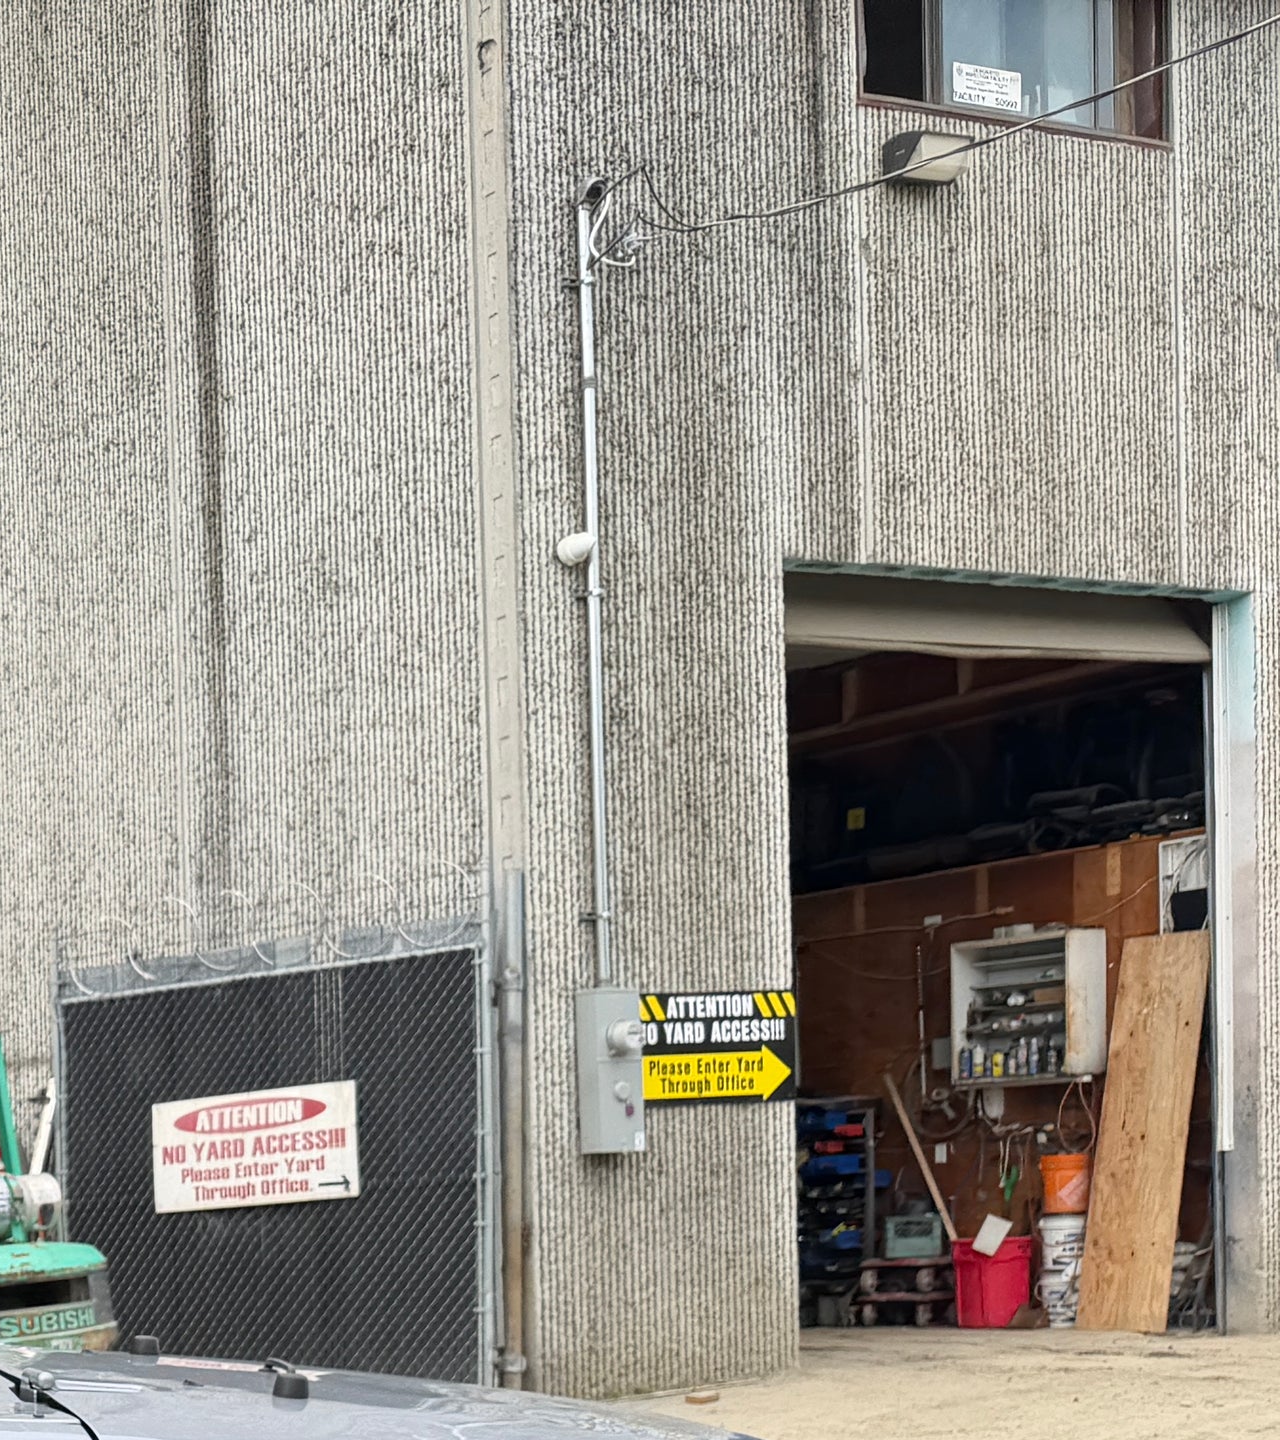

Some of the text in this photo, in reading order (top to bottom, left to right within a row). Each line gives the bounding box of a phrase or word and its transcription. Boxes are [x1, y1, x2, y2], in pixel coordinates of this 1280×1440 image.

[666, 994, 754, 1020] ATTENTION
[663, 1021, 705, 1045] YARD
[710, 1018, 786, 1042] ACCESS!!!
[649, 1056, 765, 1077] Please Enter Yard
[659, 1075, 755, 1097] Through Office
[195, 1099, 304, 1133] ATTENTION
[162, 1127, 346, 1166] NO YARD ACCESS!!!
[181, 1155, 326, 1184] Please Enter Yard
[193, 1182, 256, 1202] Through
